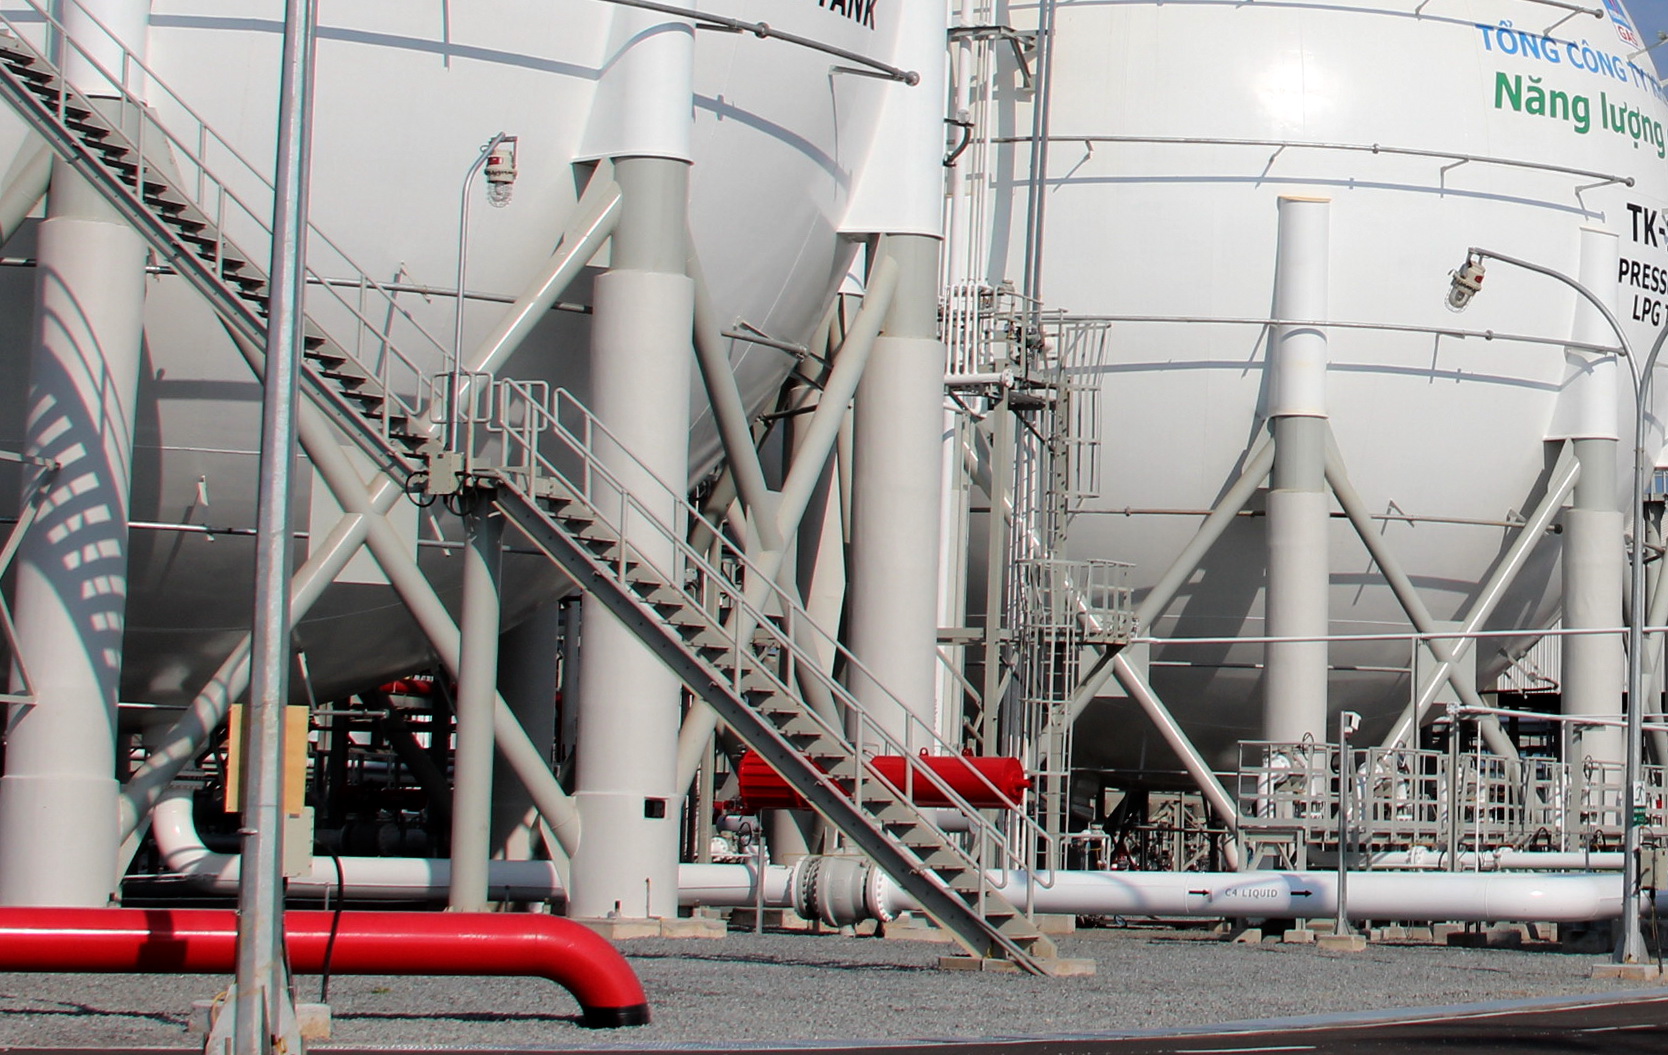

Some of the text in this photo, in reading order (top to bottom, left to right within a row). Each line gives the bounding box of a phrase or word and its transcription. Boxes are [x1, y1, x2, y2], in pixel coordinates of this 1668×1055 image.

[1475, 20, 1561, 63] TỔNG
[1566, 39, 1627, 82] CÔNG
[1617, 25, 1639, 47] GAS
[1494, 71, 1591, 134] Năng
[1600, 91, 1665, 159] lượng
[1632, 294, 1661, 327] LPG
[1225, 888, 1278, 898] C4 LIQUID
